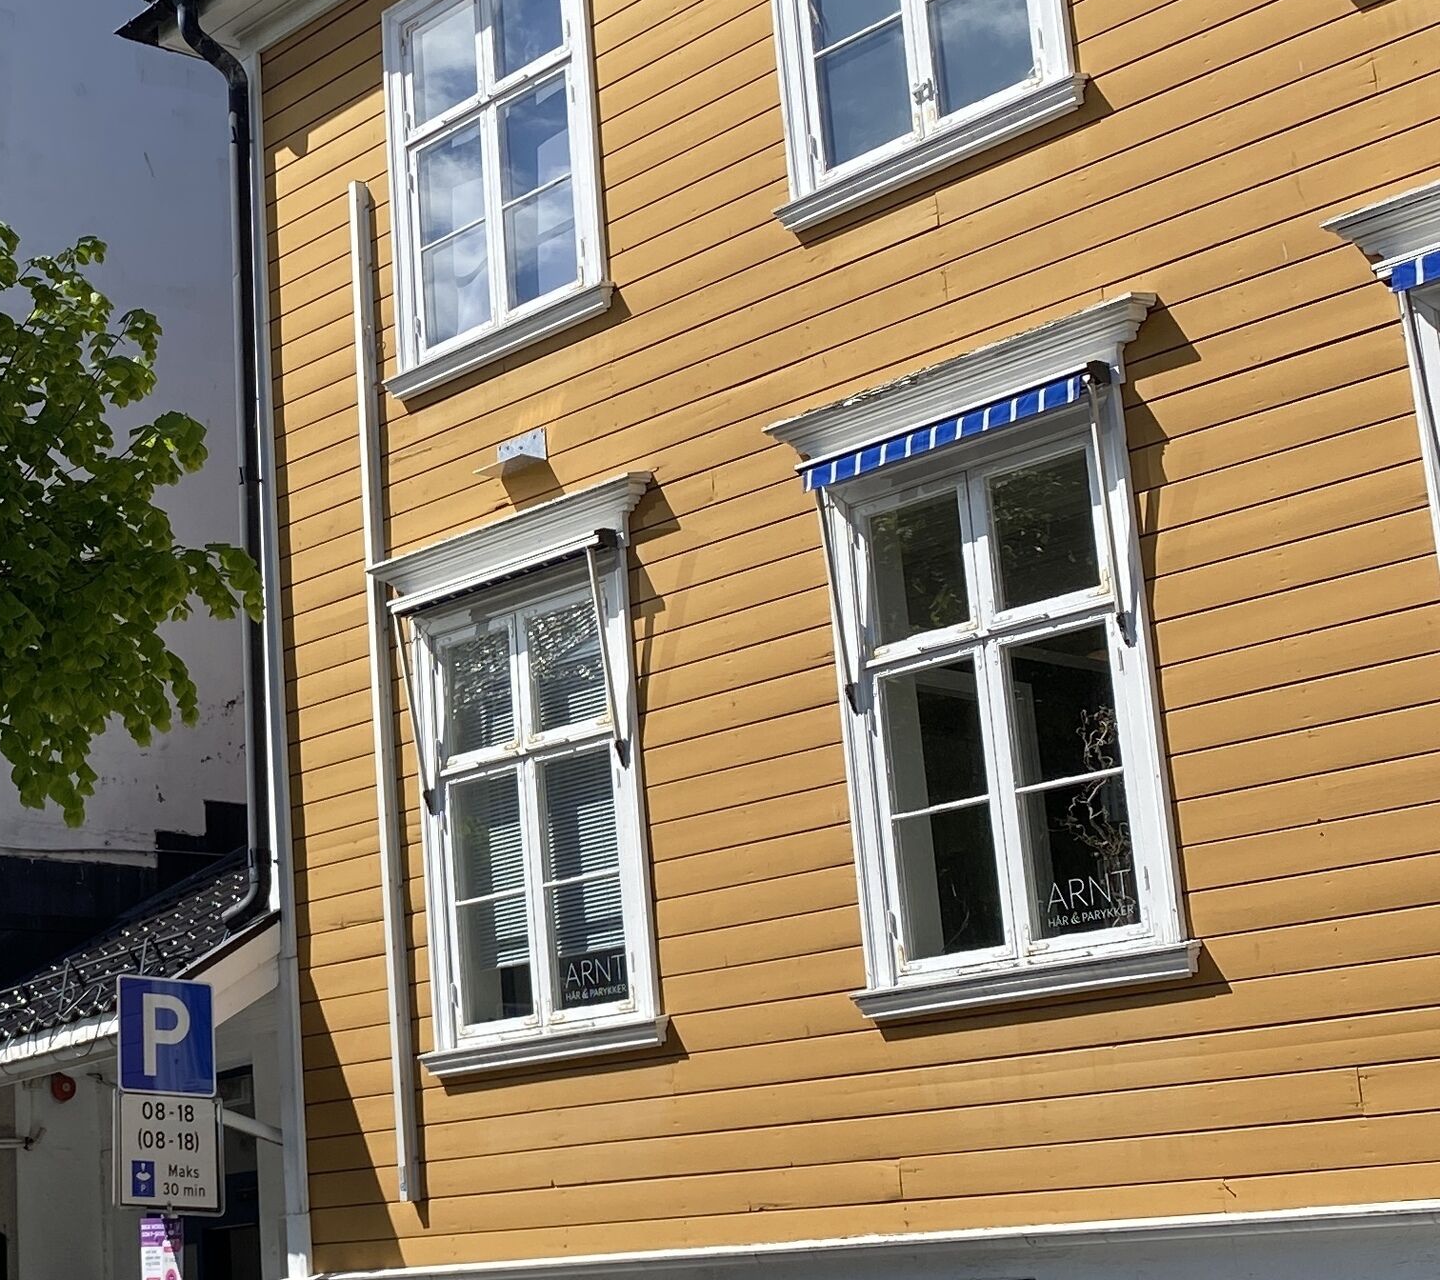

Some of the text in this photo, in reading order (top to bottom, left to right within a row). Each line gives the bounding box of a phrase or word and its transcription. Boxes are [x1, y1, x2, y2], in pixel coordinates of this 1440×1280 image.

[1047, 868, 1131, 913] ARNT
[1071, 911, 1081, 925] &
[1081, 905, 1134, 922] PARYKKER
[565, 954, 625, 989] ARNT
[590, 984, 627, 998] PARYKKER
[142, 993, 190, 1076] P
[142, 1101, 194, 1122] 08-18
[138, 1127, 199, 1153] (08-18)
[168, 1164, 200, 1179] Maks
[163, 1182, 206, 1197] 30 min
